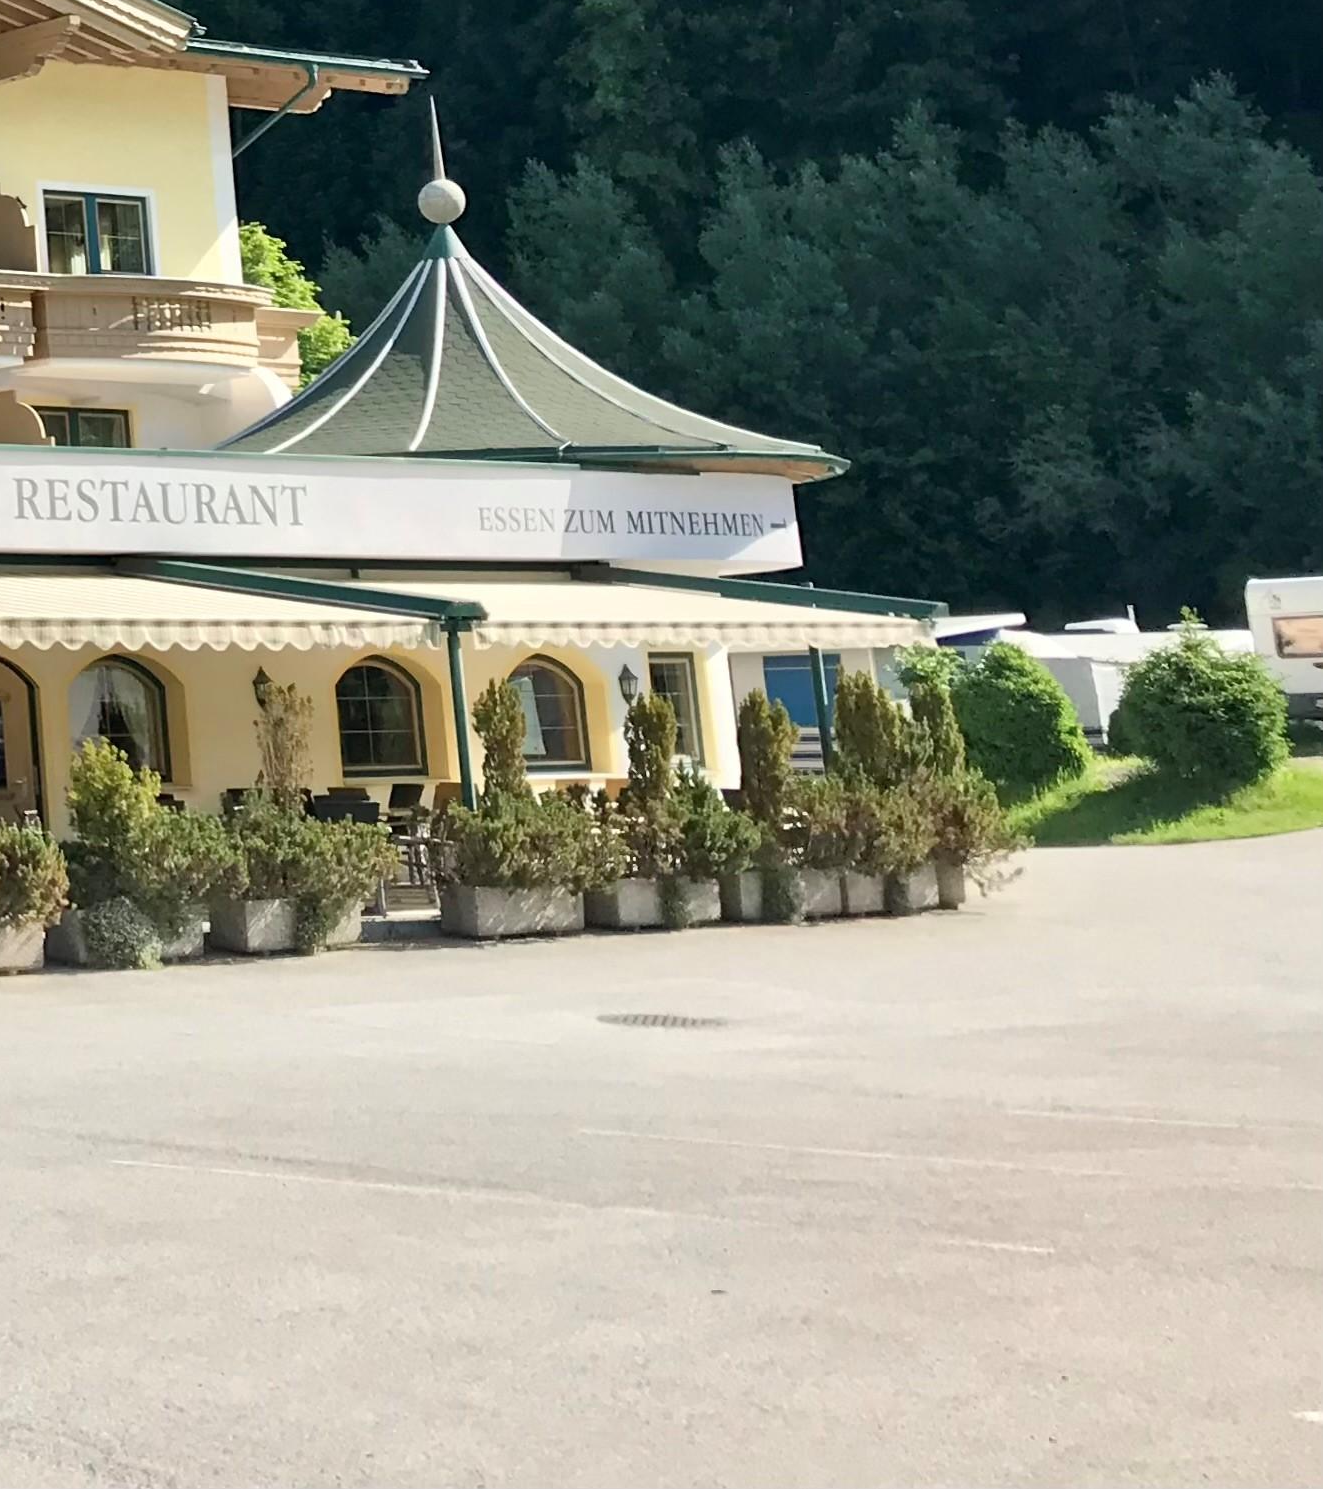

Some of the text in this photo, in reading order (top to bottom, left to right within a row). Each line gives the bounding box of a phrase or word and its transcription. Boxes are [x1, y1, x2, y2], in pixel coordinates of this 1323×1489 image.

[11, 476, 308, 527] RESTAURANT
[477, 506, 765, 538] ESSEN ZUM MITNEHMEN
